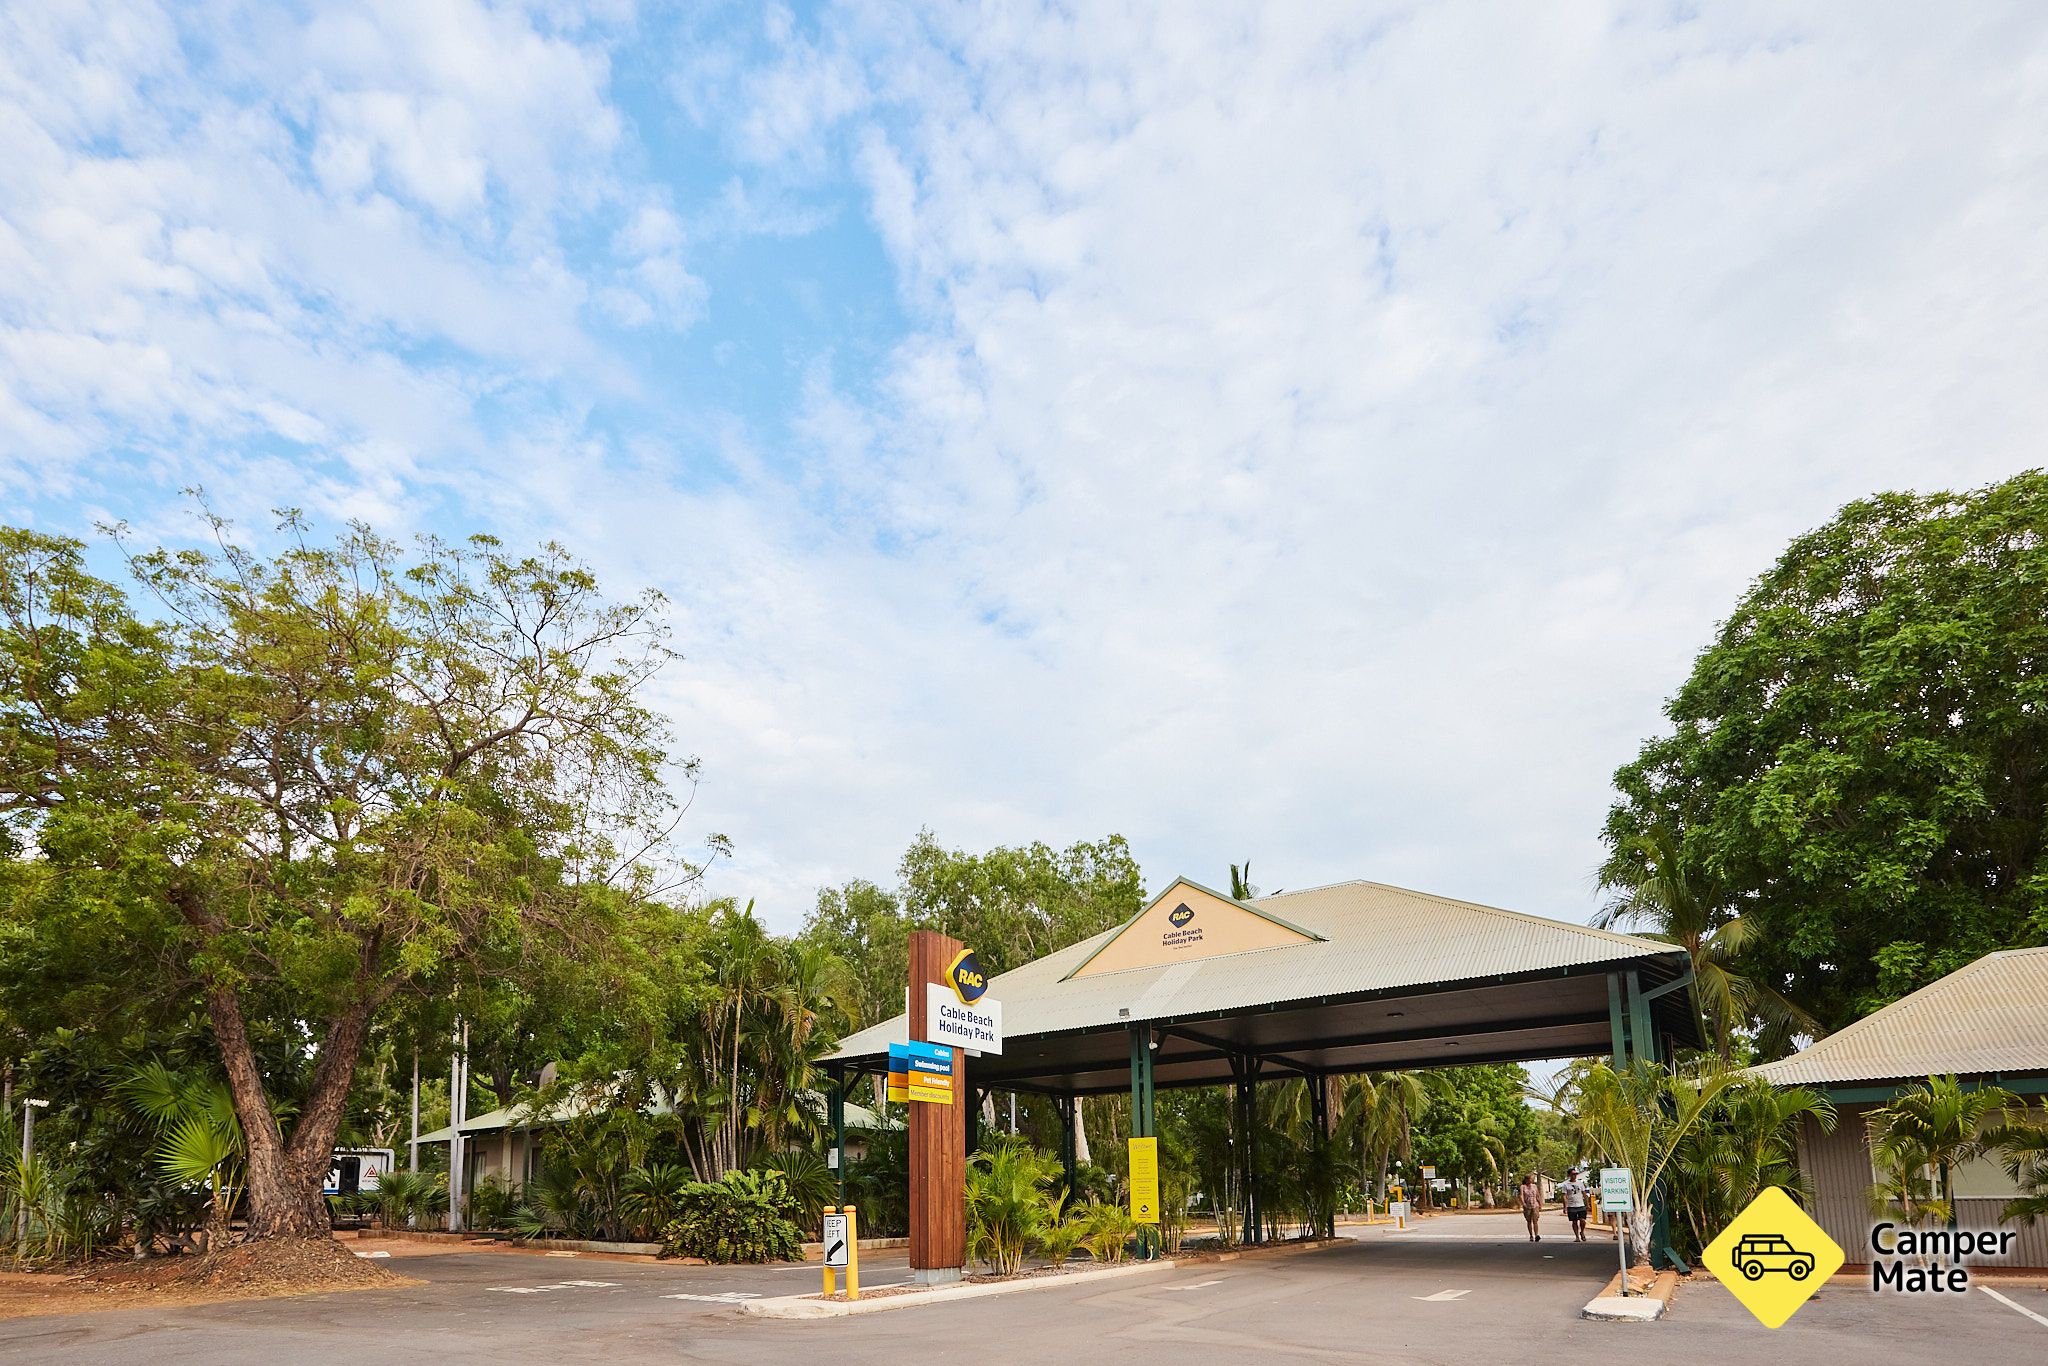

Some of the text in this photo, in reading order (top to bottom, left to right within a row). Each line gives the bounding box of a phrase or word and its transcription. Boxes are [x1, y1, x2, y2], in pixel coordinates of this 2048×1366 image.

[1173, 911, 1190, 921] RAC
[1163, 928, 1202, 940] Cable Beach
[1163, 938, 1187, 946] Holiday
[958, 968, 983, 988] RAC
[940, 1005, 993, 1027] Cable Beach
[939, 1020, 994, 1042] Holiday Park
[914, 1059, 950, 1073] Swimming pool
[923, 1076, 950, 1088] Pet Friendly
[827, 1230, 840, 1238] LEFT
